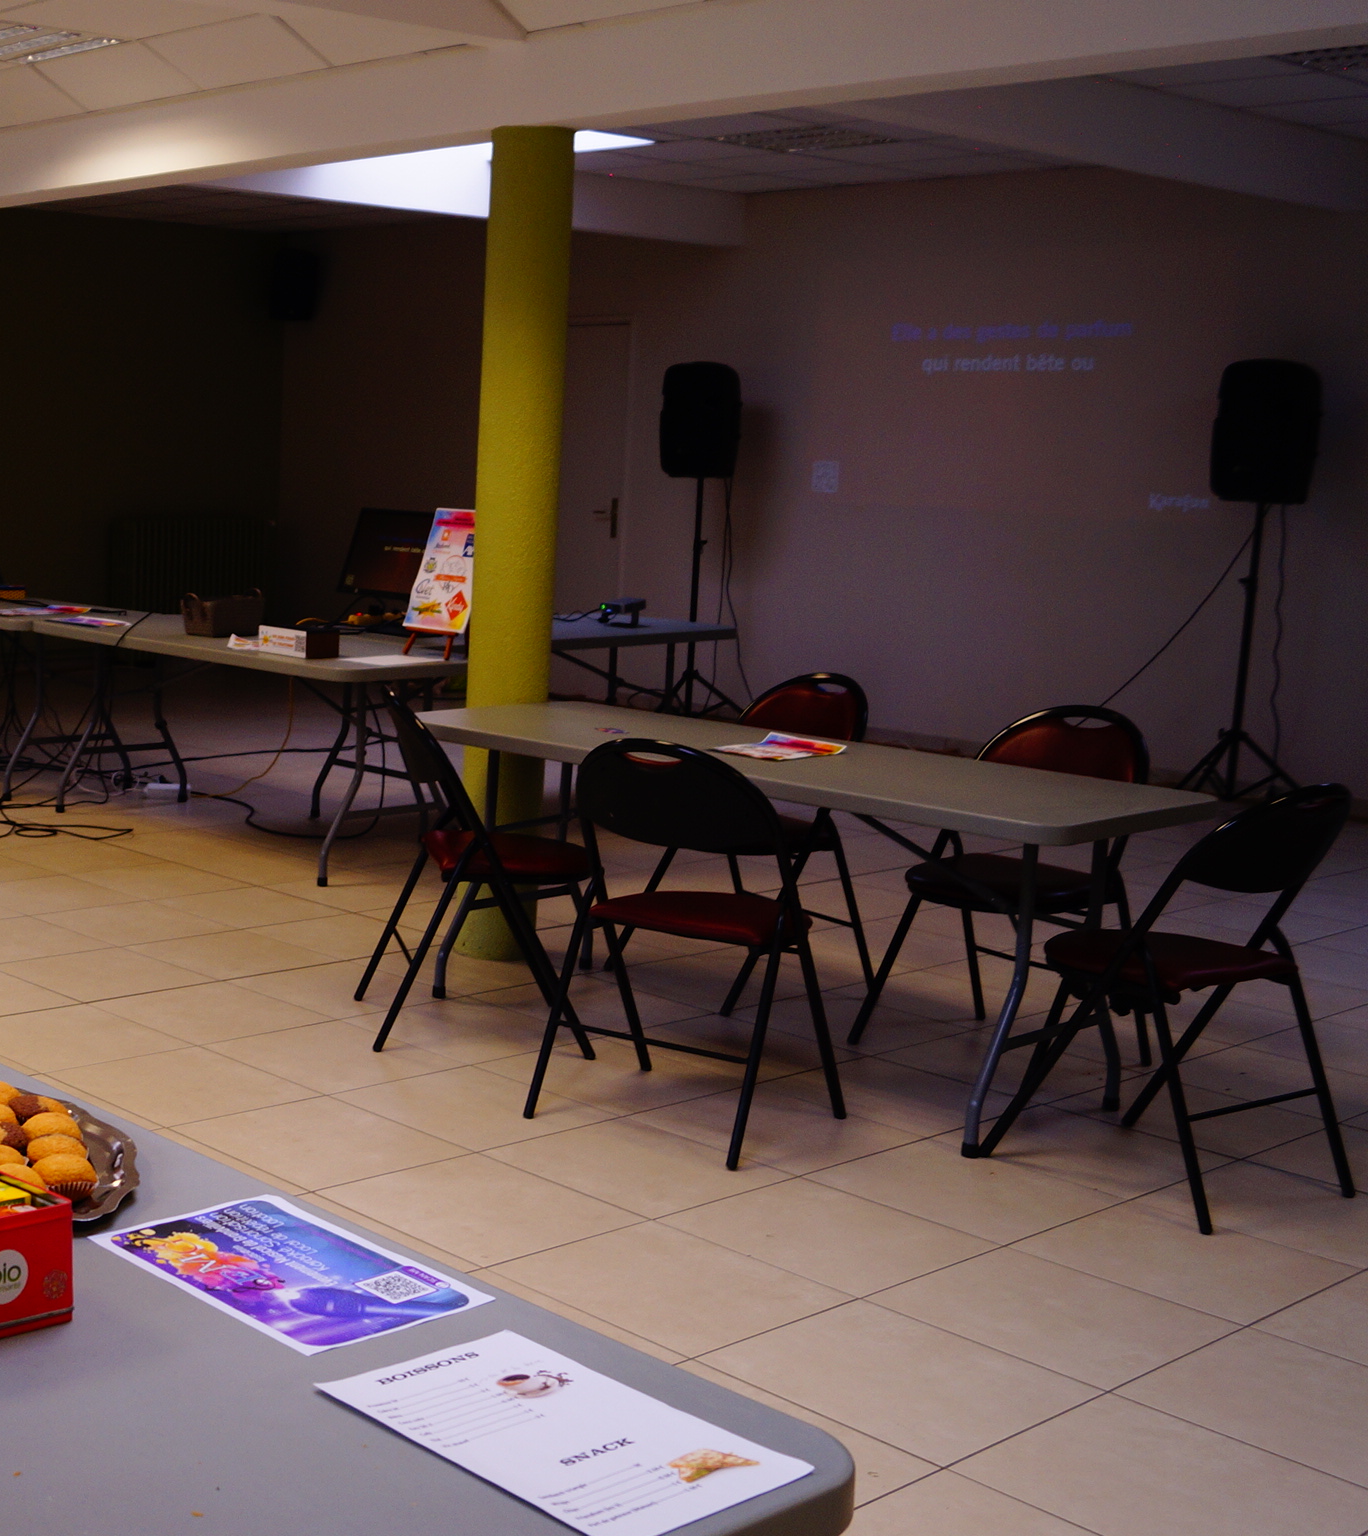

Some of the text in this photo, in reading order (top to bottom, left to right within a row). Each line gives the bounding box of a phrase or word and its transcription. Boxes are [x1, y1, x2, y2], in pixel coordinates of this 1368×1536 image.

[891, 323, 922, 343] Elle
[1036, 321, 1060, 340] de
[921, 353, 1095, 375] qui rendent bête ou
[238, 1203, 285, 1228] Location
[209, 1211, 281, 1248] Sonorisation
[270, 1231, 289, 1241] de
[287, 1238, 318, 1255] Local
[375, 1351, 480, 1386] BOISSONS
[559, 1437, 636, 1467] SNACK
